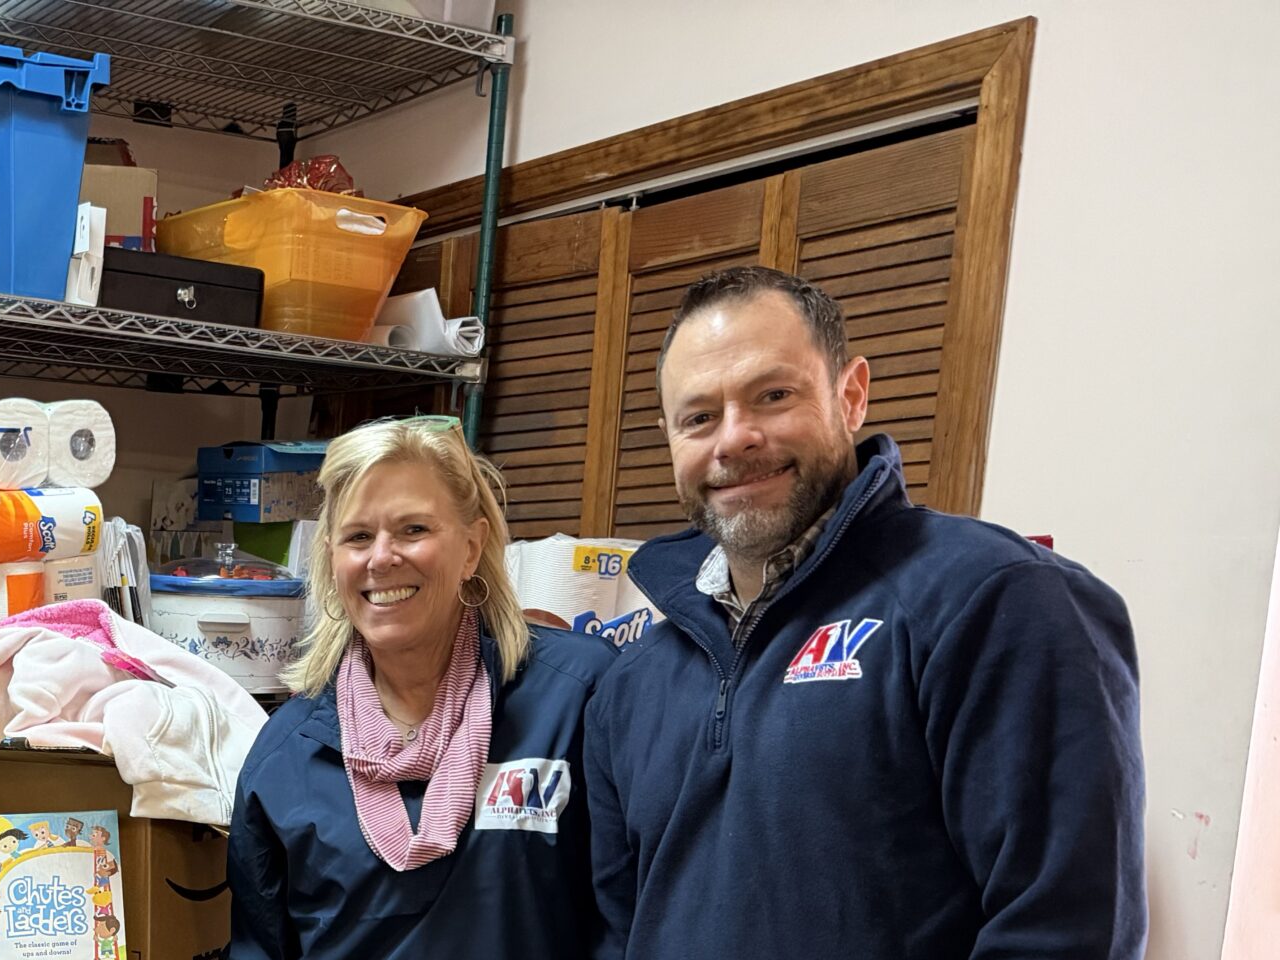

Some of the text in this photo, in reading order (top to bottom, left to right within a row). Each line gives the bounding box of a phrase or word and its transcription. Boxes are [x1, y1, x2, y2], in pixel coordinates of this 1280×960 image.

[83, 510, 96, 525] 4
[40, 521, 56, 551] Scott
[584, 555, 591, 565] 8
[597, 553, 623, 576] 16
[8, 875, 86, 910] Chutes
[4, 905, 88, 938] Ladders
[17, 906, 31, 914] and
[52, 940, 70, 948] game
